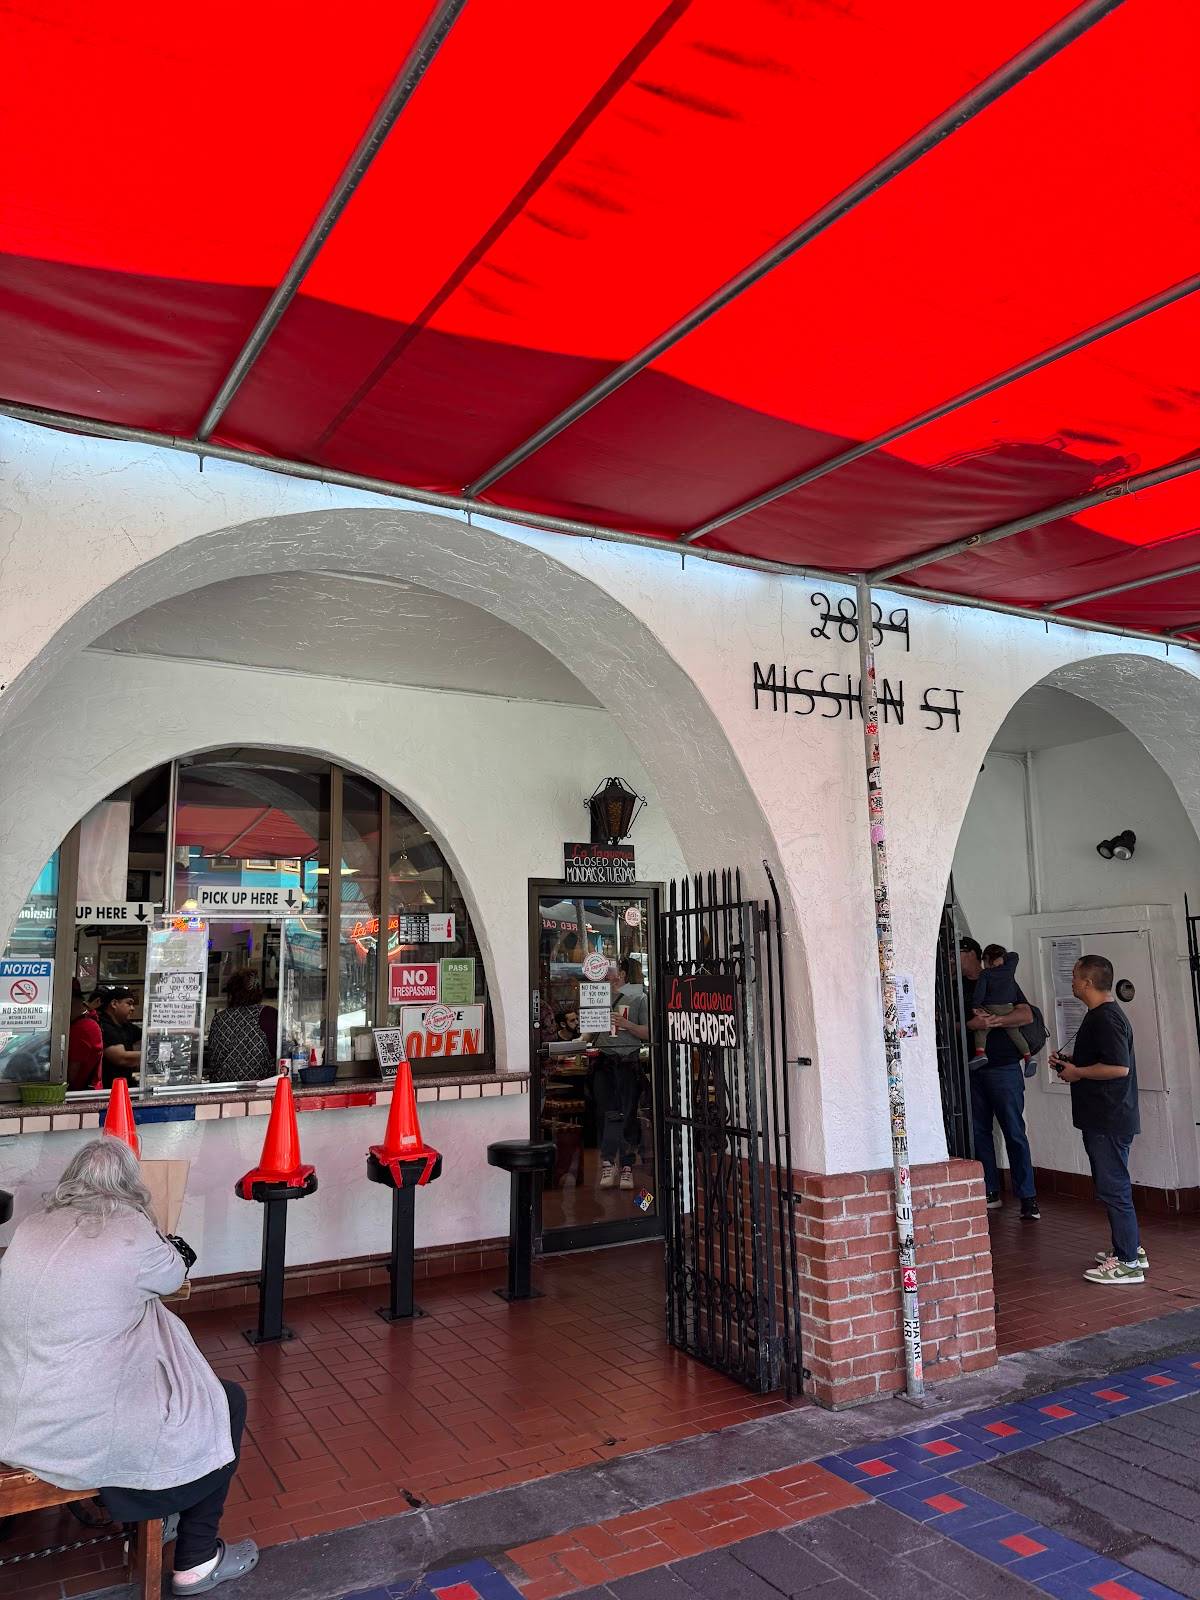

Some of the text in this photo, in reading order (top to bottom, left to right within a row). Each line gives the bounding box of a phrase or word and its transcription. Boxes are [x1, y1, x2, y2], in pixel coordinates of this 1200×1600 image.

[753, 661, 904, 725] MISSIN
[920, 687, 964, 733] ST
[573, 856, 628, 867] CLOSED ON
[202, 891, 278, 905] PICK UP HERE
[75, 906, 127, 919] UP HERE
[3, 964, 48, 975] NOTICE
[448, 964, 468, 972] PASS
[403, 970, 428, 986] NO
[393, 986, 436, 997] TRESPASSING
[668, 977, 734, 1012] La Taqueria
[2, 1006, 43, 1015] NO SMOKING
[667, 1011, 737, 1048] PHONE ORDERS
[405, 1028, 480, 1059] OPEN
